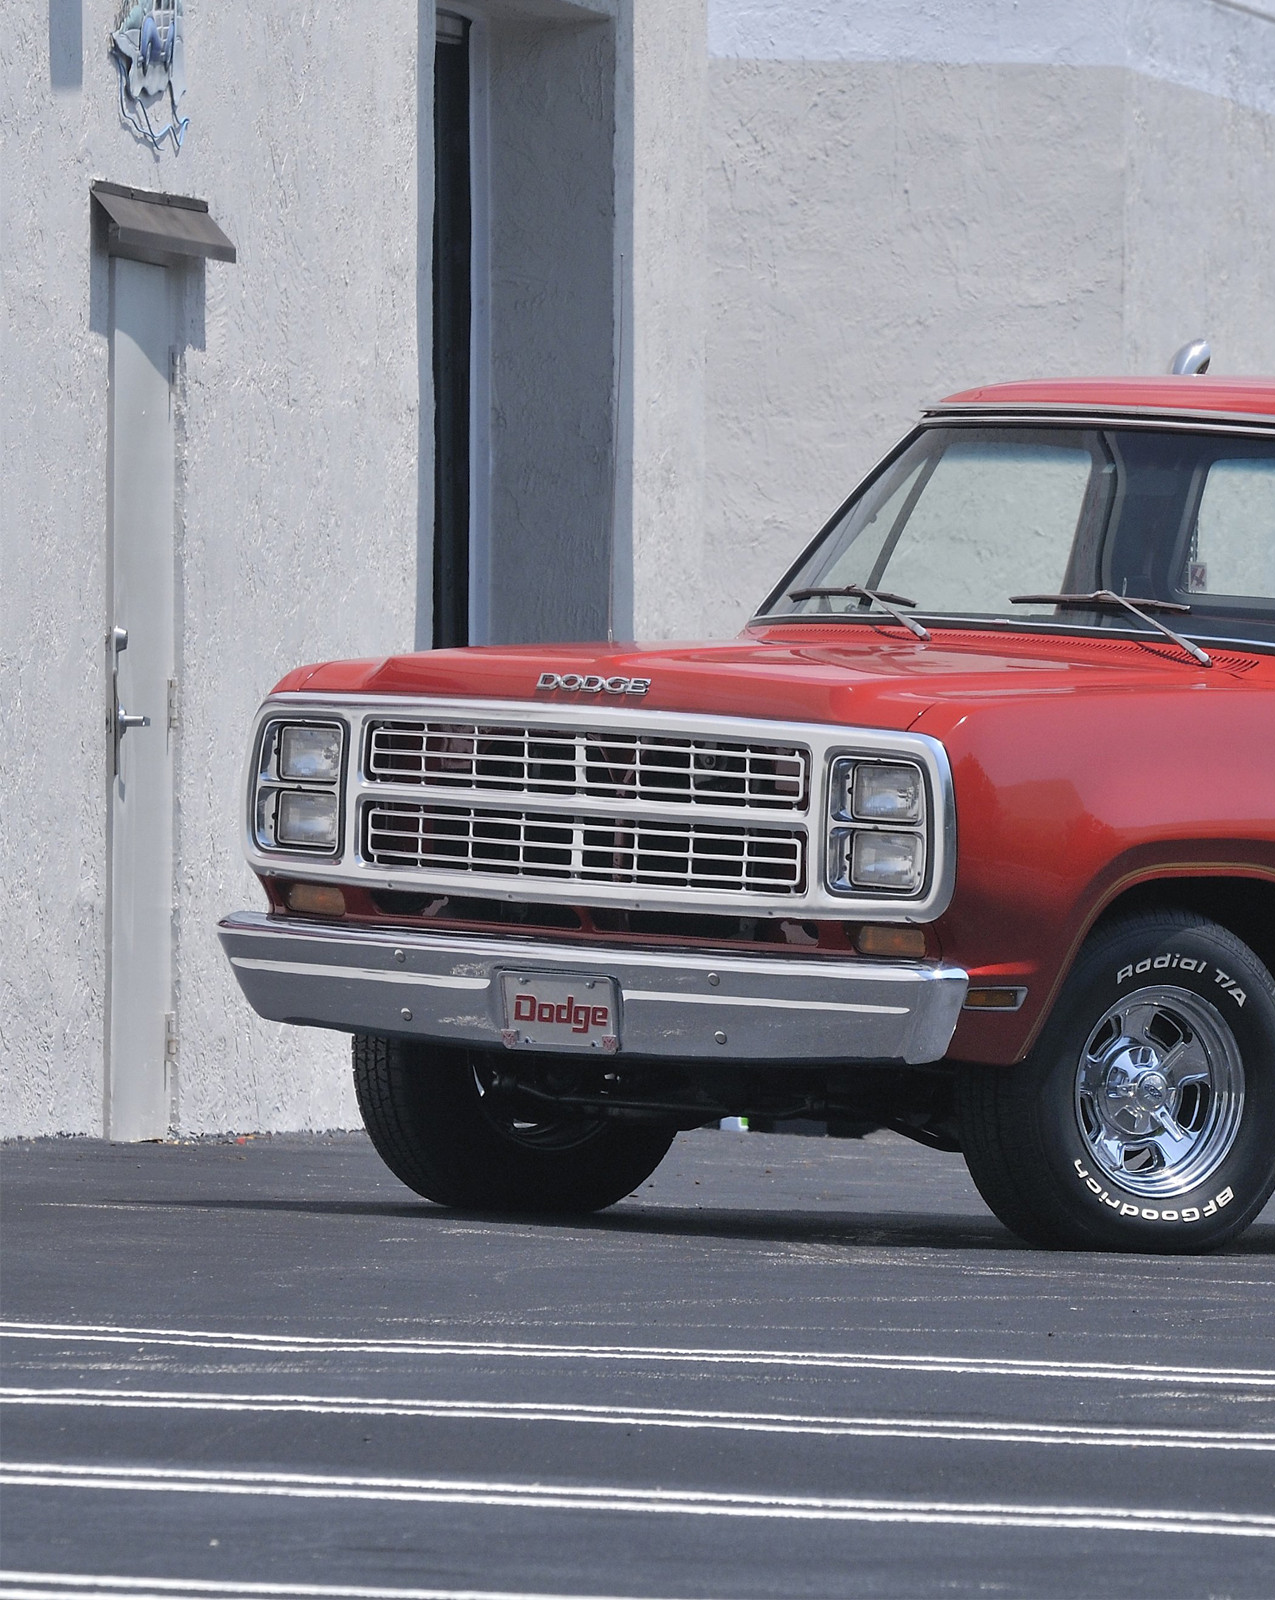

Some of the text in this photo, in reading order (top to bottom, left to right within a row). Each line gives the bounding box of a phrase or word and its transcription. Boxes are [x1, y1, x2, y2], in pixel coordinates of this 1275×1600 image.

[536, 672, 652, 696] DODGE
[1116, 952, 1248, 1008] Radial T/A
[514, 993, 609, 1034] Dodge
[1073, 1158, 1235, 1223] BFGoodrich
